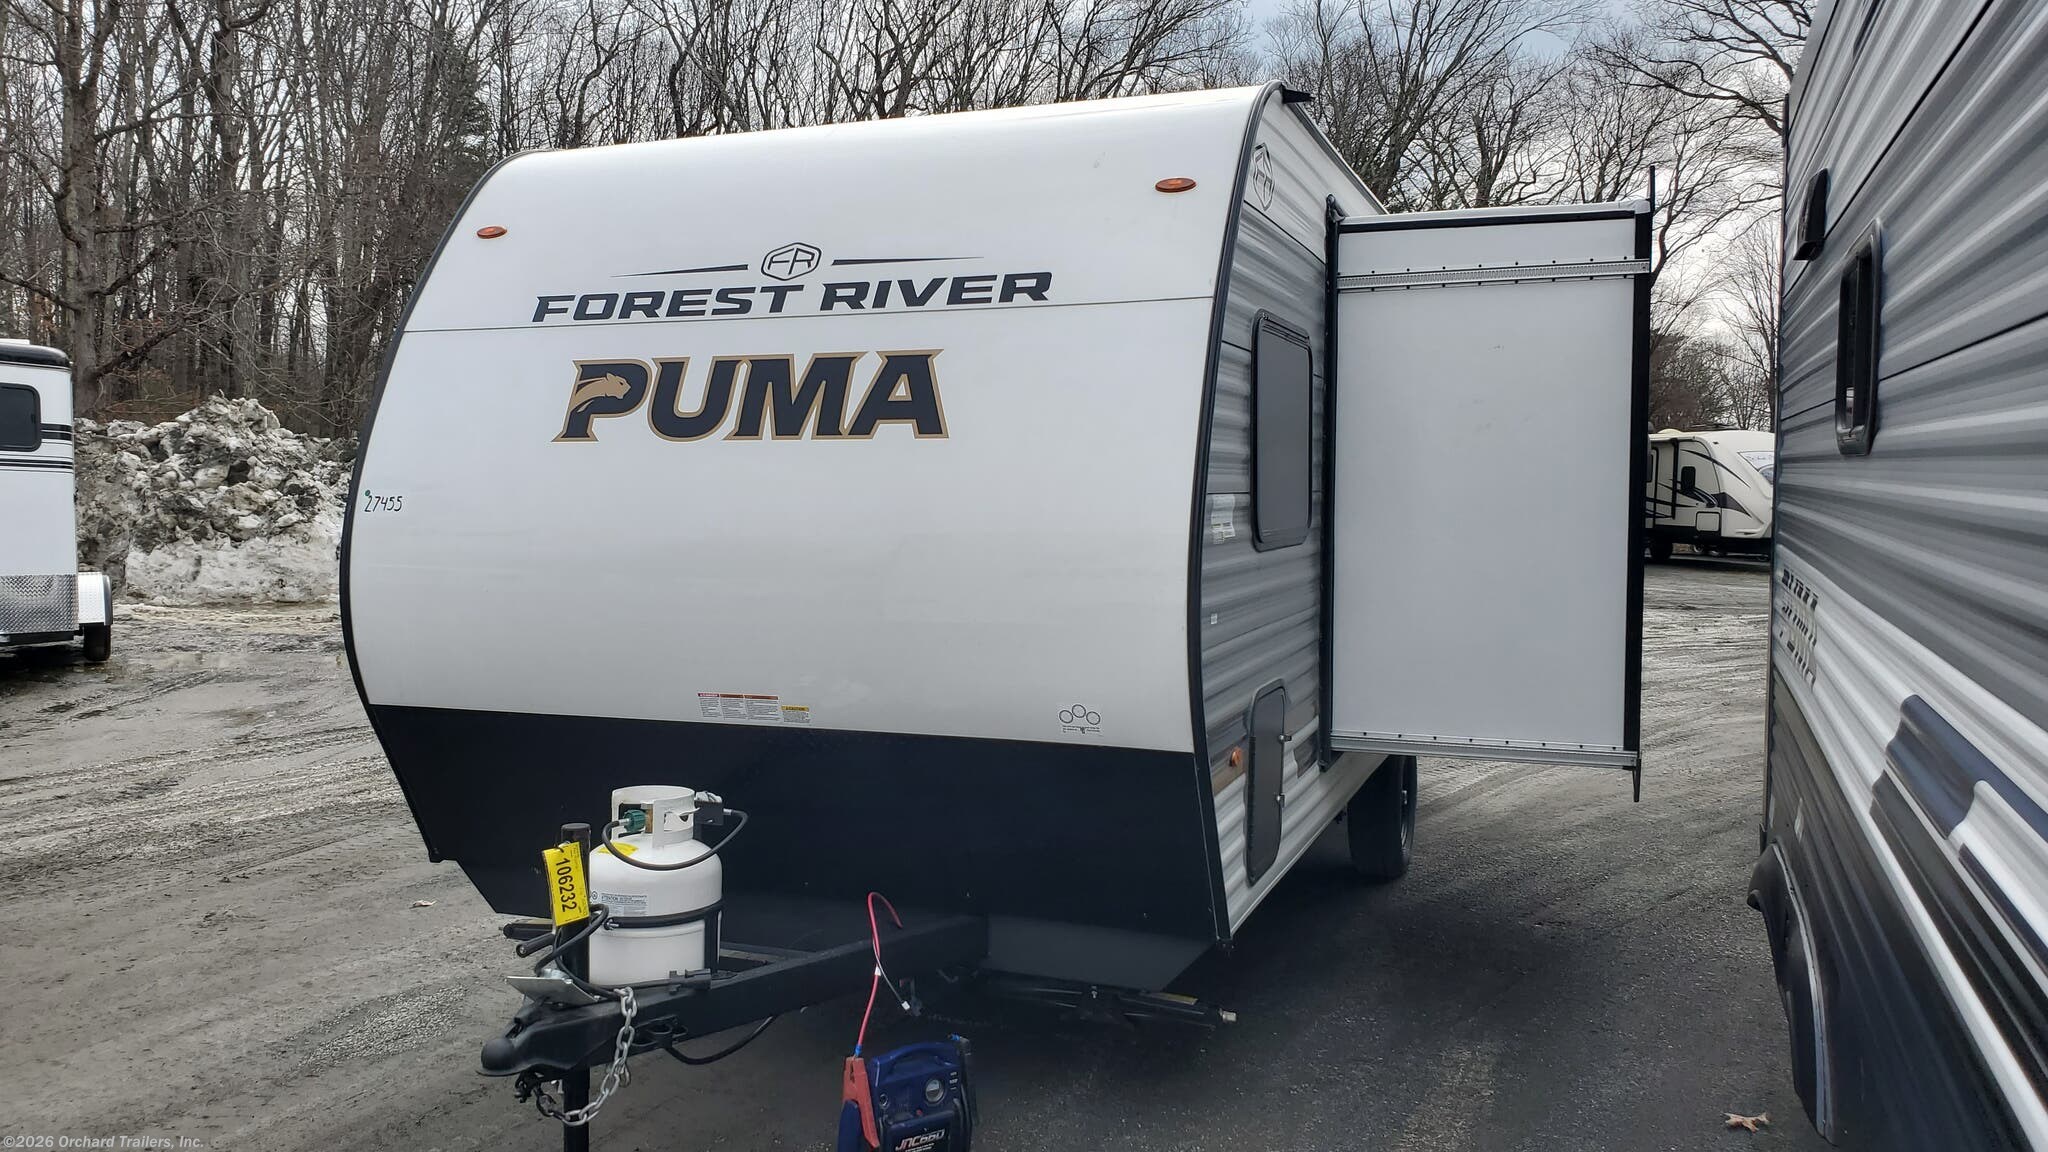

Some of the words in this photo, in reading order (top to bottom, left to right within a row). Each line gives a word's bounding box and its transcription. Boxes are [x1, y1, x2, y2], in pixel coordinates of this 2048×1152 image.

[764, 245, 819, 278] FR
[532, 285, 805, 322] FOREST
[821, 272, 1052, 311] RIVER
[551, 349, 950, 443] PUMA
[364, 495, 403, 512] 27455
[556, 858, 577, 912] 106232
